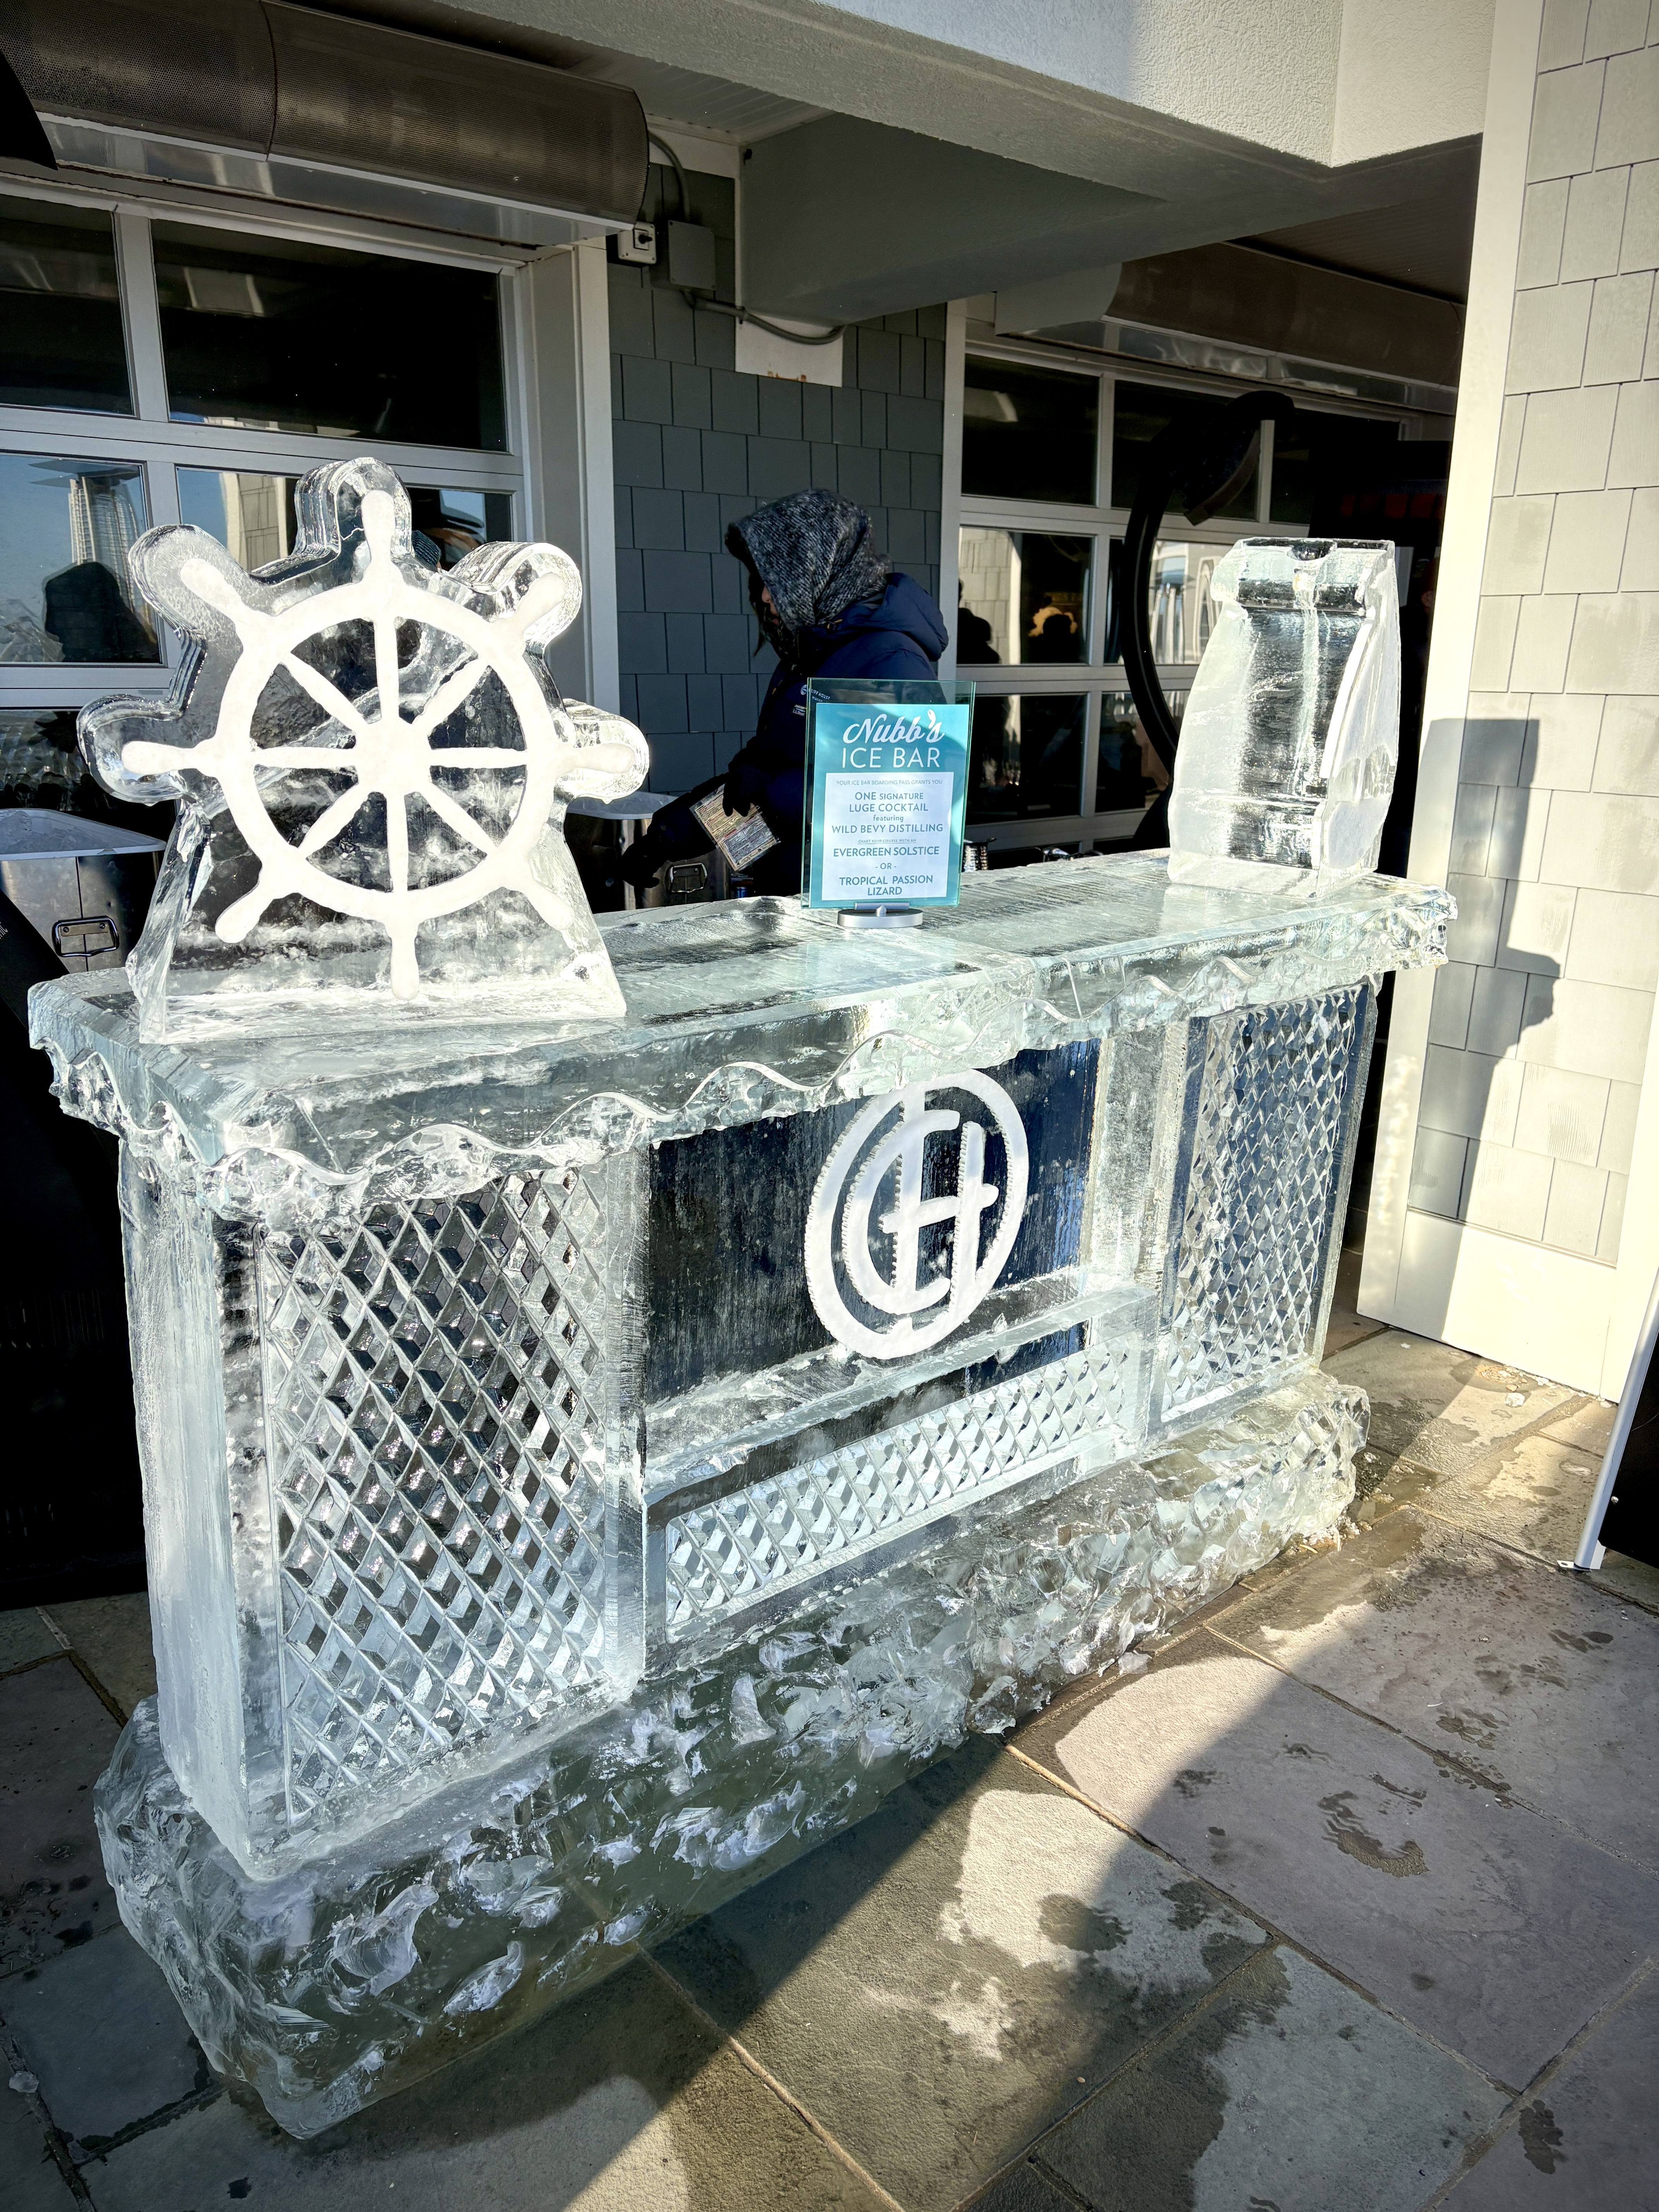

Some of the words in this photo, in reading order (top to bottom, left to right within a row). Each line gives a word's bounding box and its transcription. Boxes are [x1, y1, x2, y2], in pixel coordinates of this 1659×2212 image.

[843, 709, 945, 744] Nubb's
[842, 747, 882, 768] ICE
[893, 747, 940, 768] BAR
[855, 792, 876, 800] ONE
[849, 804, 875, 812] LUGE
[878, 803, 928, 812] COCKTAIL
[832, 825, 857, 833] WILD
[860, 825, 886, 833] BEVY
[889, 824, 943, 833] DISTILLING
[833, 847, 891, 857] EVERGREEN
[893, 846, 939, 856] SOLSTICE
[839, 876, 888, 886] TROPICAL
[892, 875, 933, 884] PASSION
[867, 887, 902, 896] LIZARD
